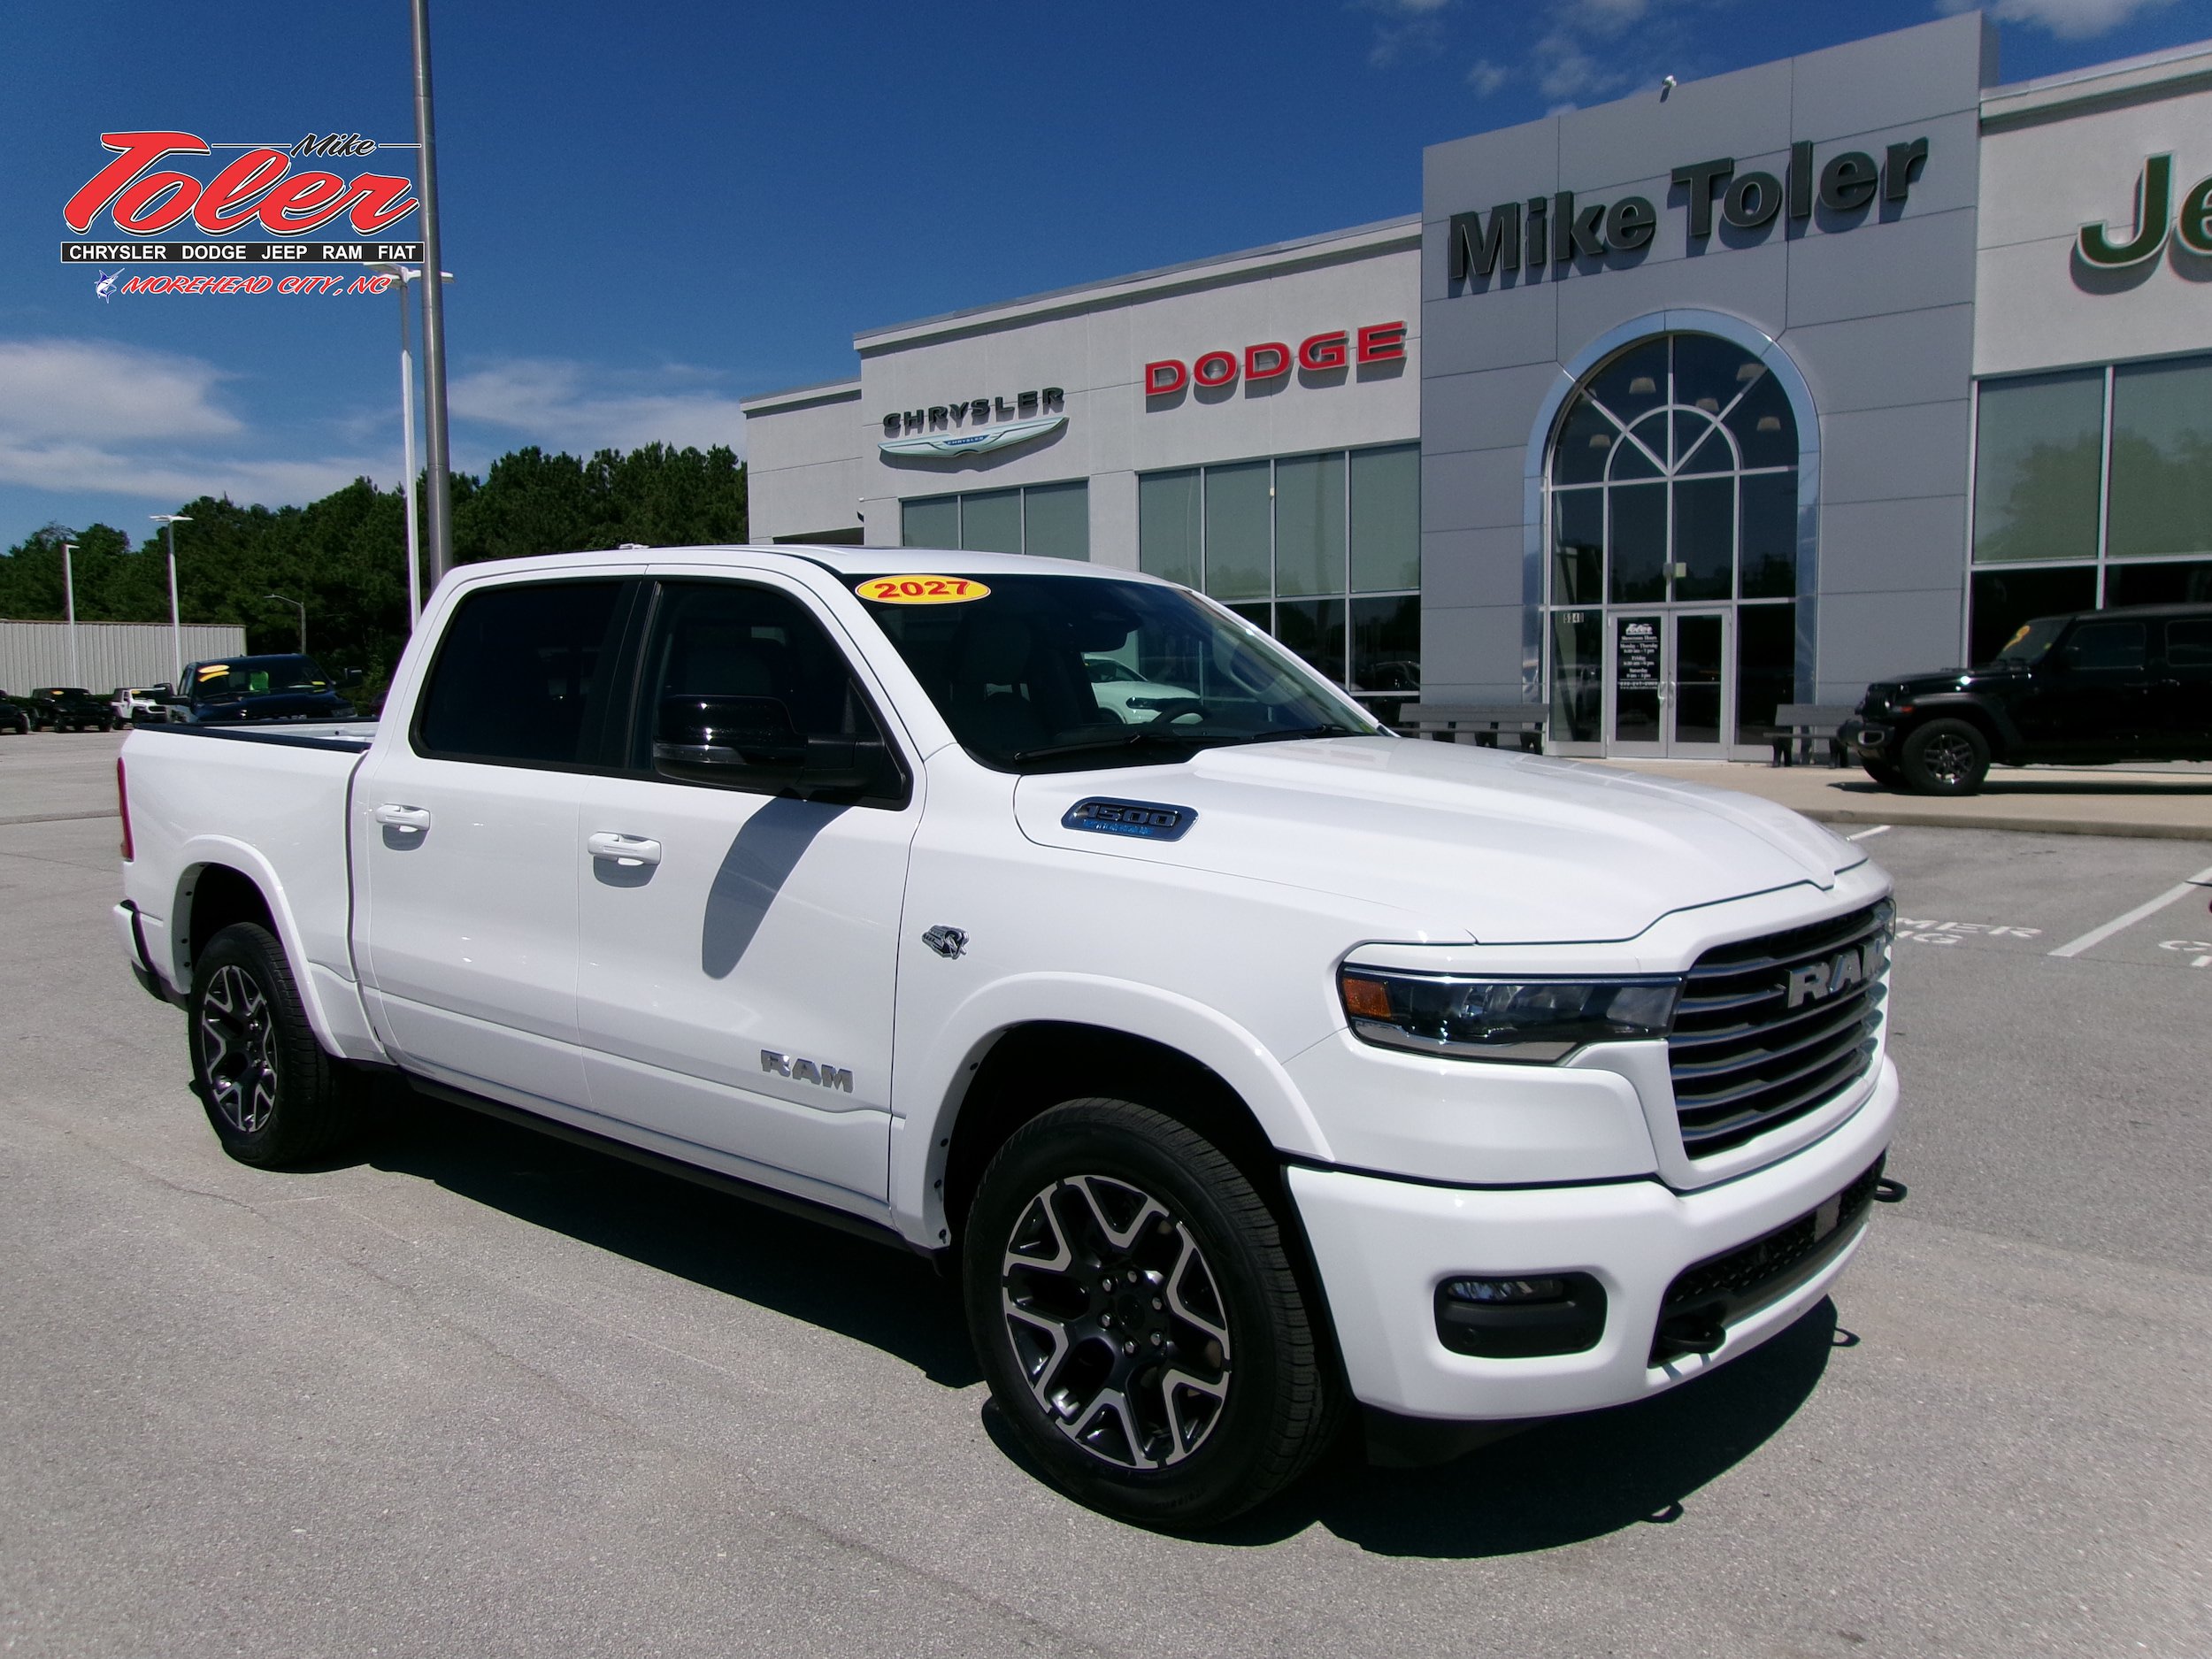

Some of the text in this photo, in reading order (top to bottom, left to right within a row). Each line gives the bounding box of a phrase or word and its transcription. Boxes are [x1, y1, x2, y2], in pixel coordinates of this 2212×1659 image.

[1448, 136, 1930, 279] Mike Toler
[1145, 320, 1406, 396] DODGE
[882, 387, 1065, 429] CHRYSLER
[947, 436, 984, 445] CHRYSLER
[873, 580, 971, 599] 2027
[1074, 804, 1177, 828] 1500
[1786, 934, 1886, 1009] RAM
[761, 1049, 853, 1094] RAM
